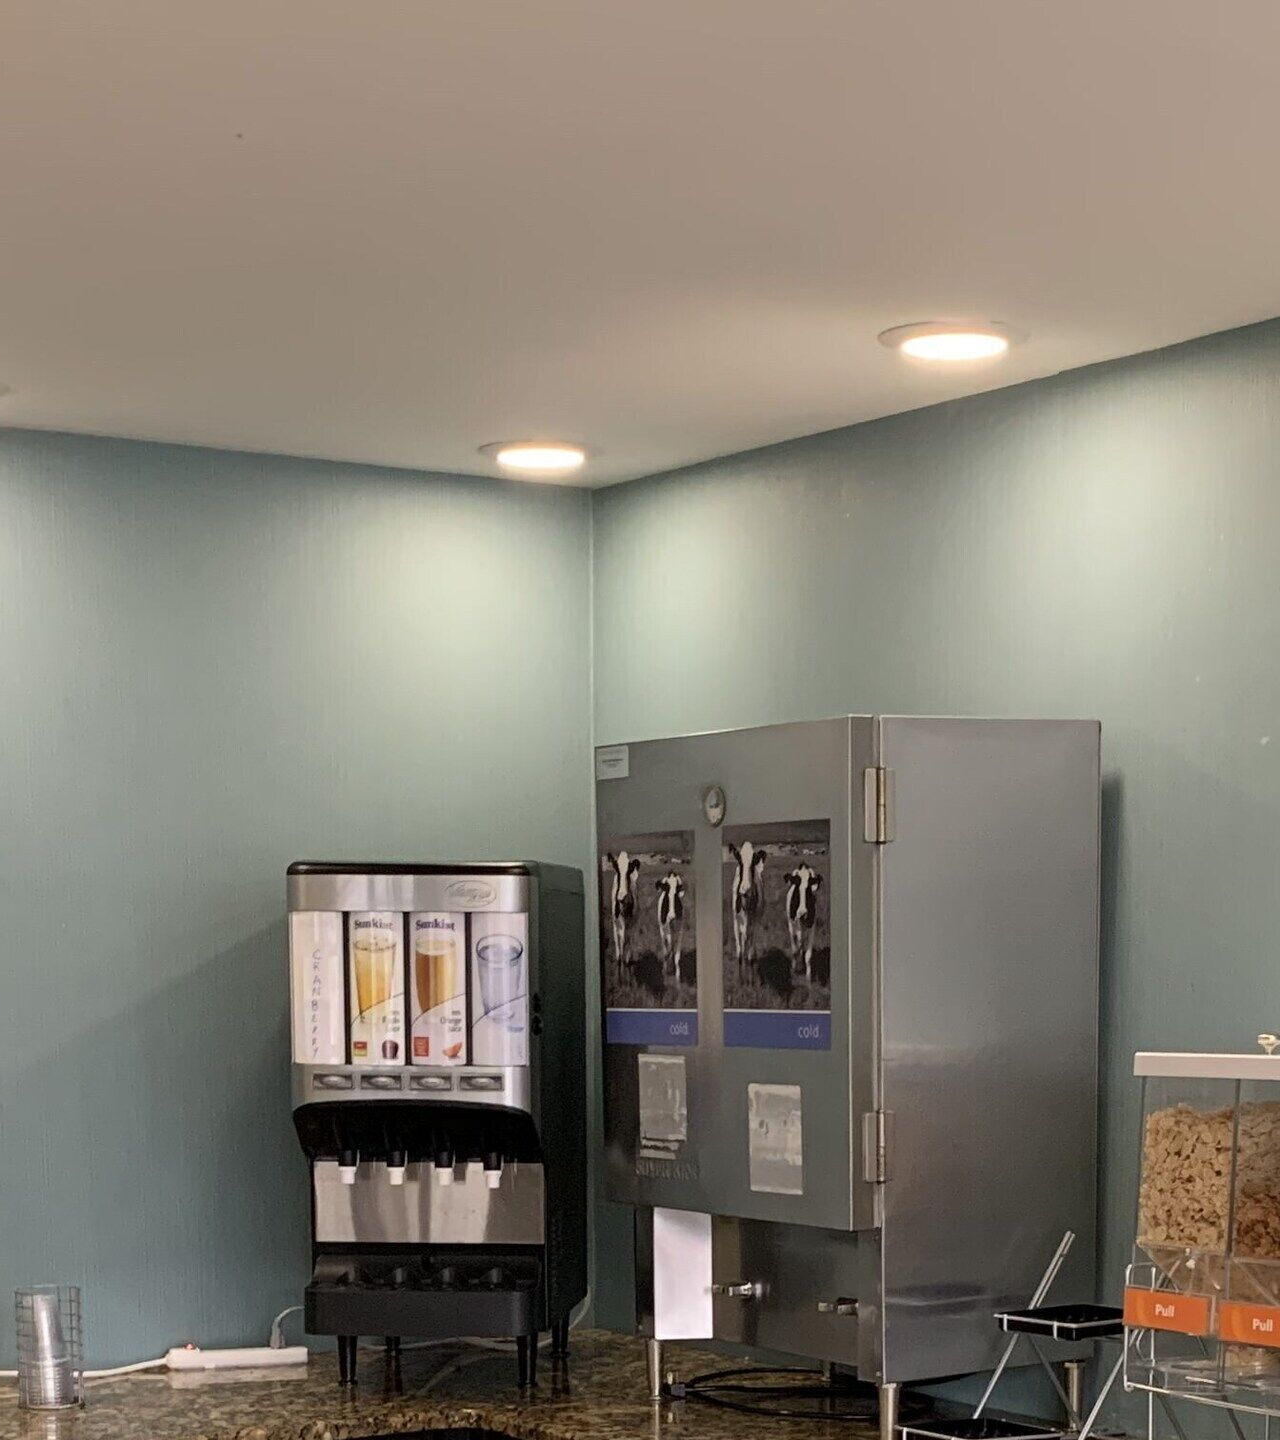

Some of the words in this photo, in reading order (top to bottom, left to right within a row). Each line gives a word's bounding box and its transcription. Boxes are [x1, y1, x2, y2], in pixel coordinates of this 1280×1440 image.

[415, 918, 455, 931] Sunkist
[1155, 1304, 1175, 1319] Pull
[1252, 1318, 1273, 1333] Pull
